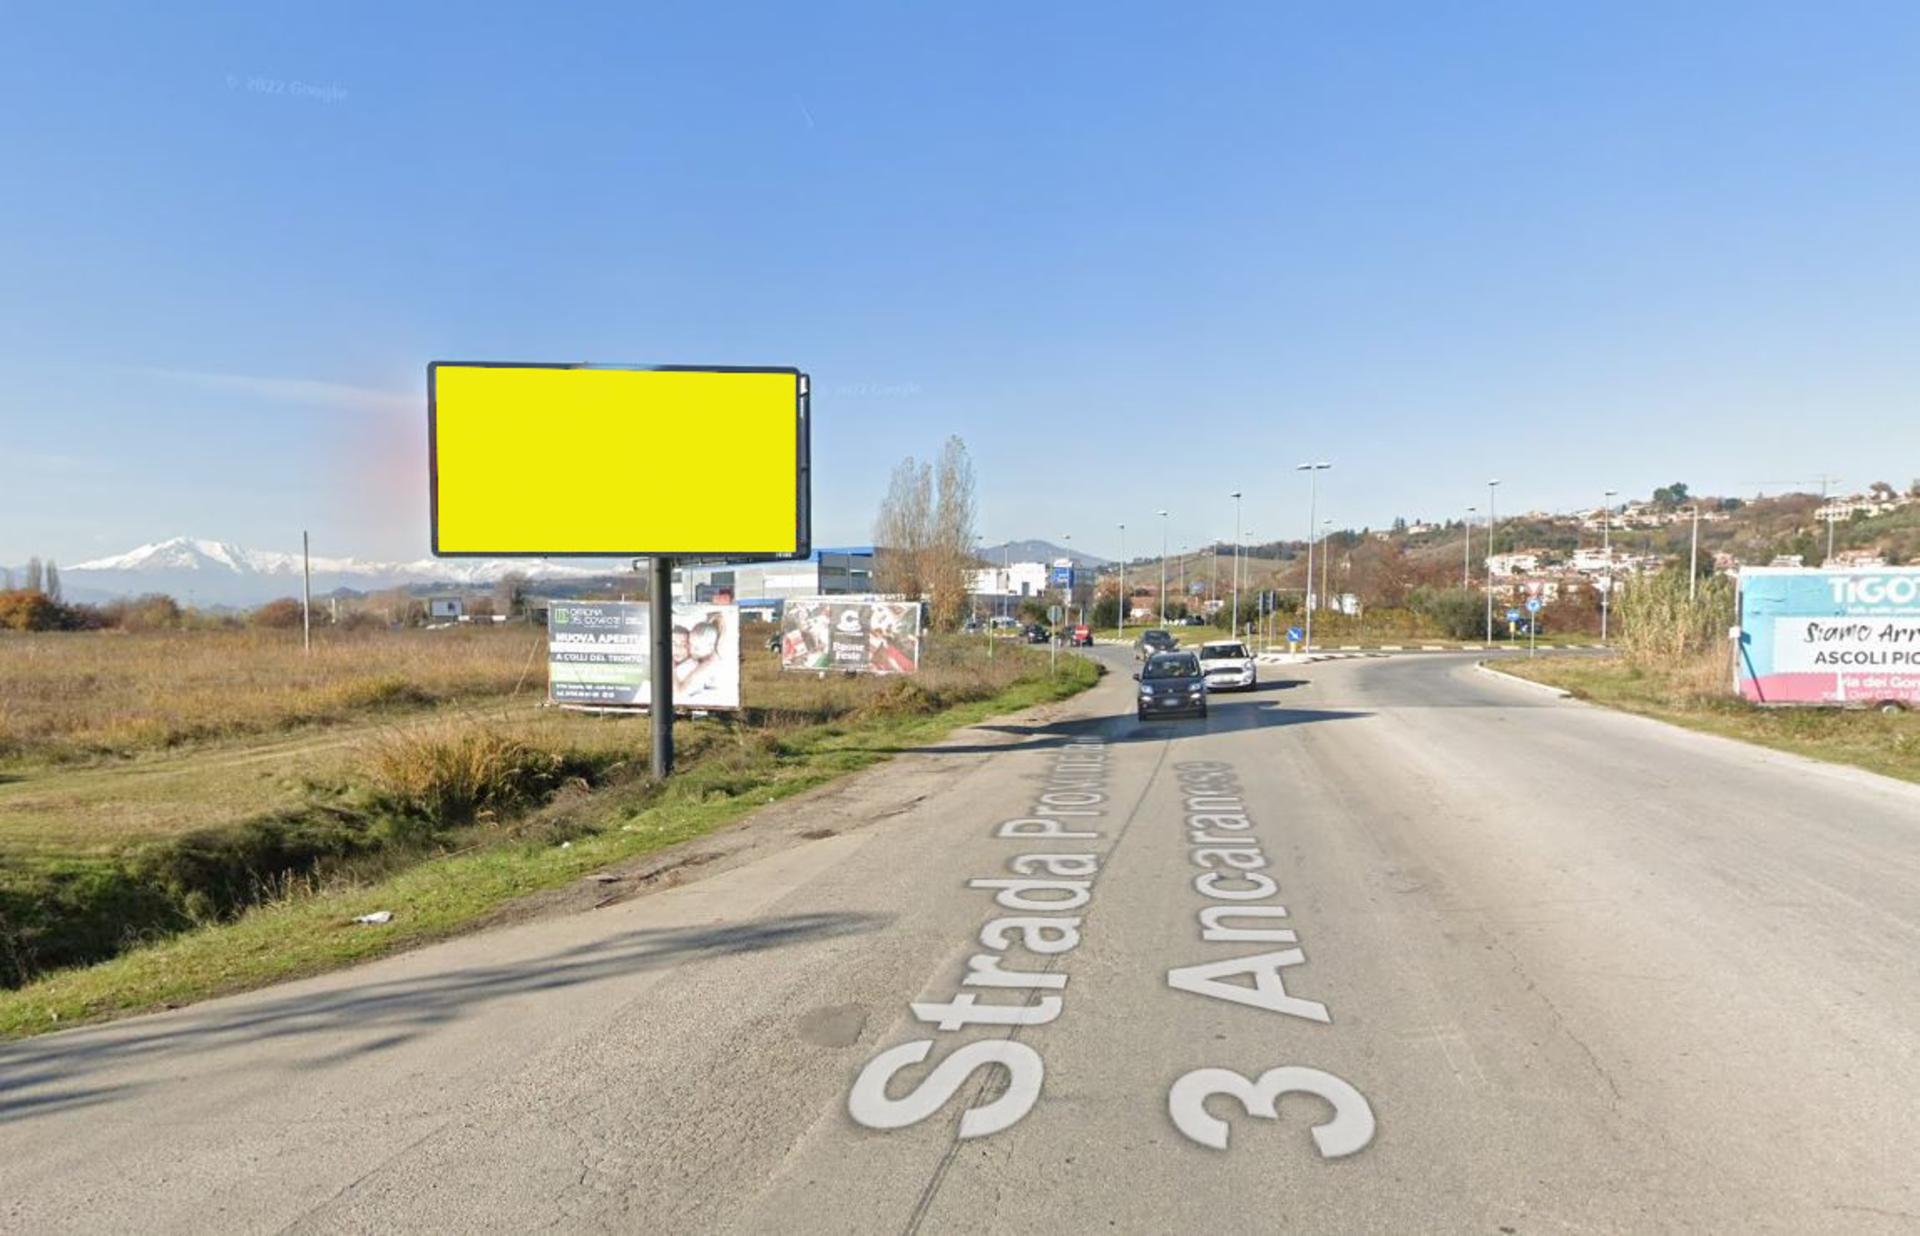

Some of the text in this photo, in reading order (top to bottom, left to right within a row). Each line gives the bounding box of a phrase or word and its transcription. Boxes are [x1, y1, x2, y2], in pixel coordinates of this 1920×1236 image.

[555, 633, 596, 643] NUOVA
[1803, 622, 1872, 643] Siamo
[1814, 650, 1920, 665] ASCOLI PIC
